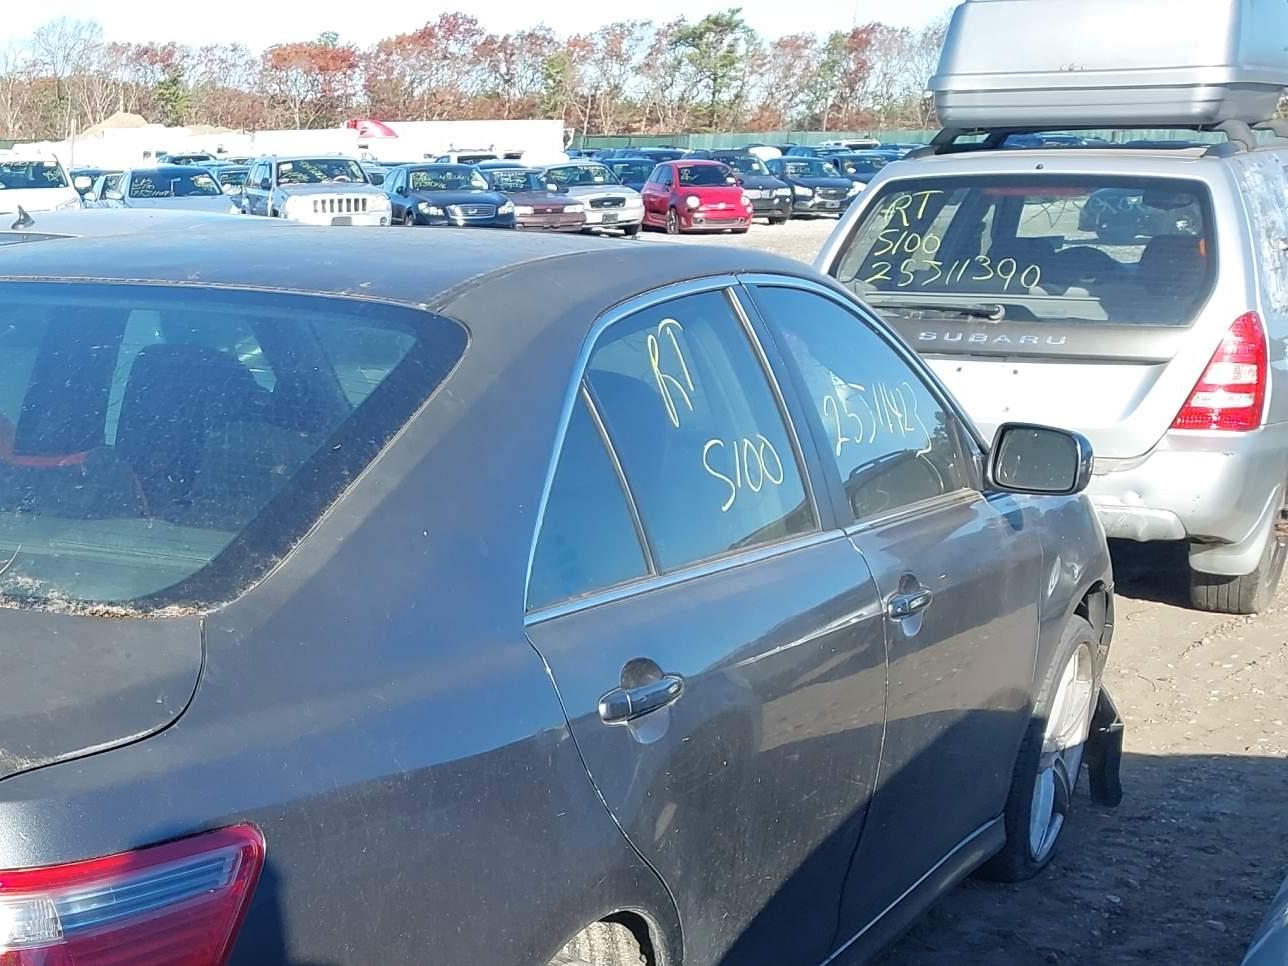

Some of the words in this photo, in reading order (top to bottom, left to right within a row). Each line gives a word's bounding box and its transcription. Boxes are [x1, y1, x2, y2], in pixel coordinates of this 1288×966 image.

[882, 190, 944, 226] RT
[918, 331, 1067, 345] SUBARU
[648, 318, 696, 428] RT
